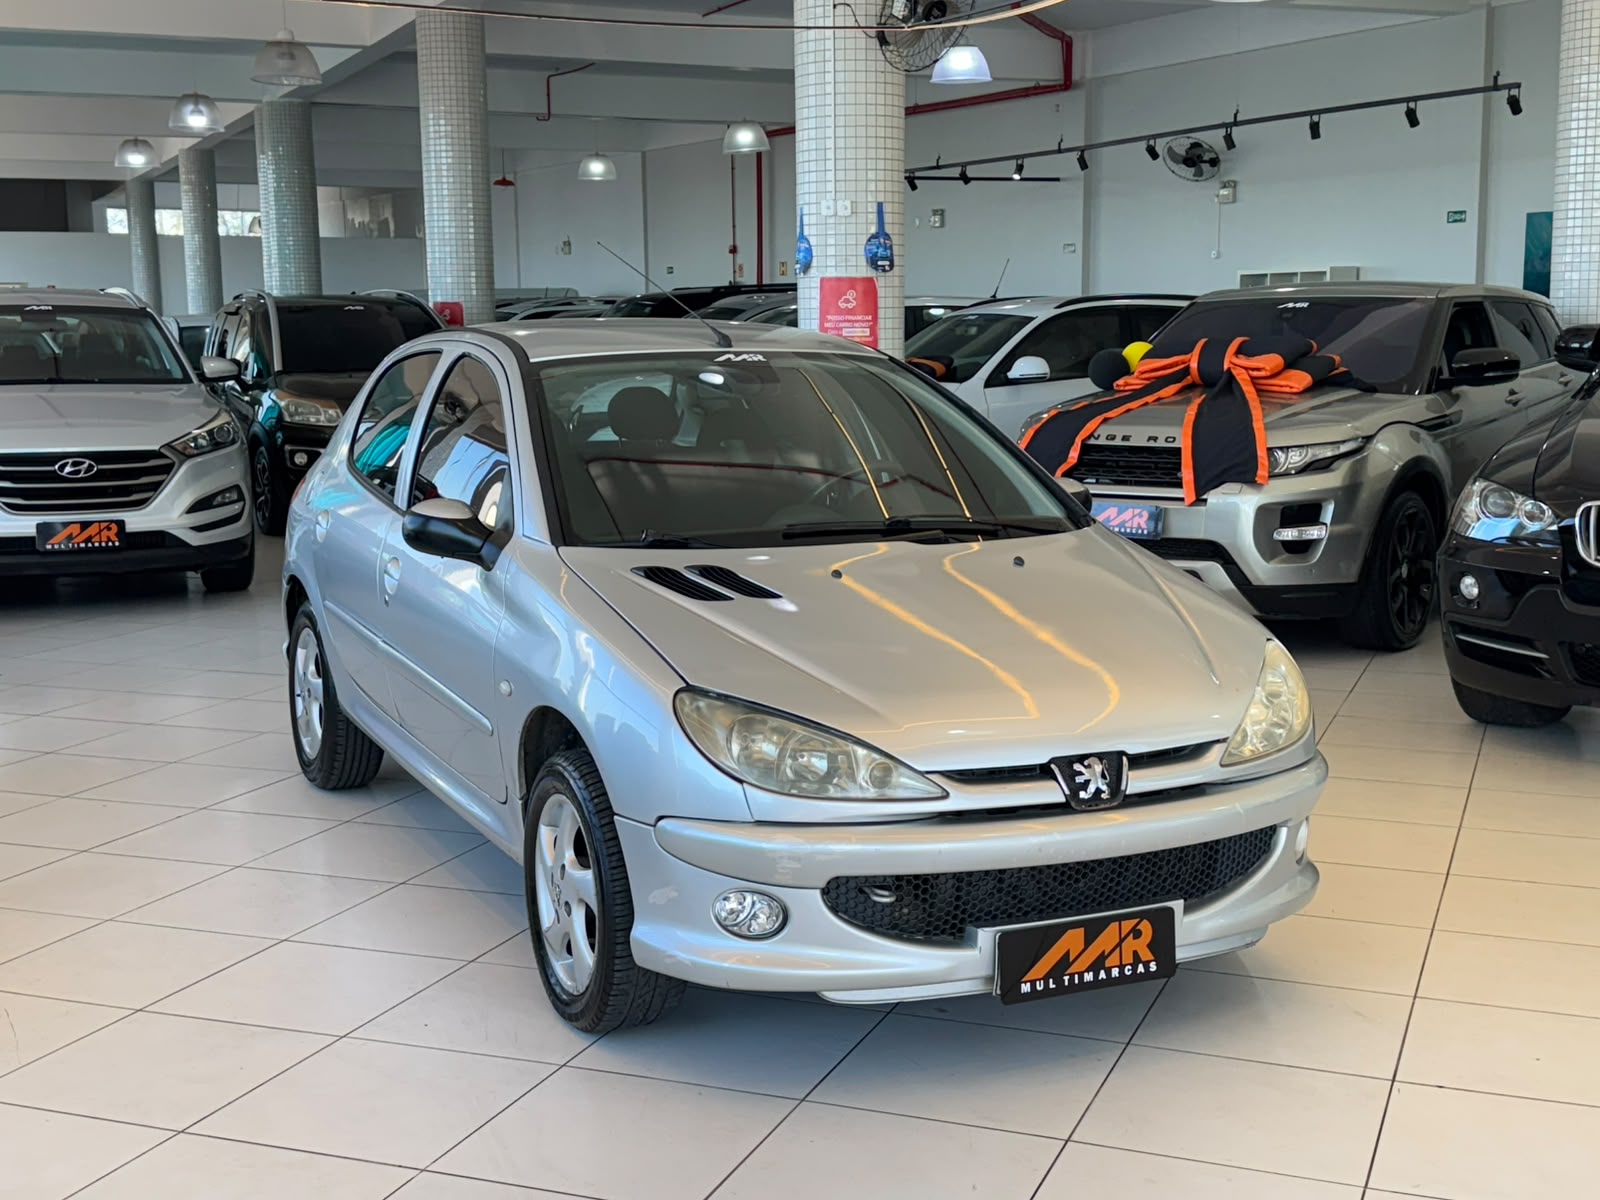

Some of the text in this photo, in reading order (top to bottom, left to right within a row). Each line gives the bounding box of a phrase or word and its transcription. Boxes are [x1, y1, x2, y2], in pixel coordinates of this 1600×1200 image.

[1088, 433, 1132, 442] NGE
[45, 541, 120, 549] MULTIMARCAS
[1020, 961, 1157, 994] MULTIMARCAS
